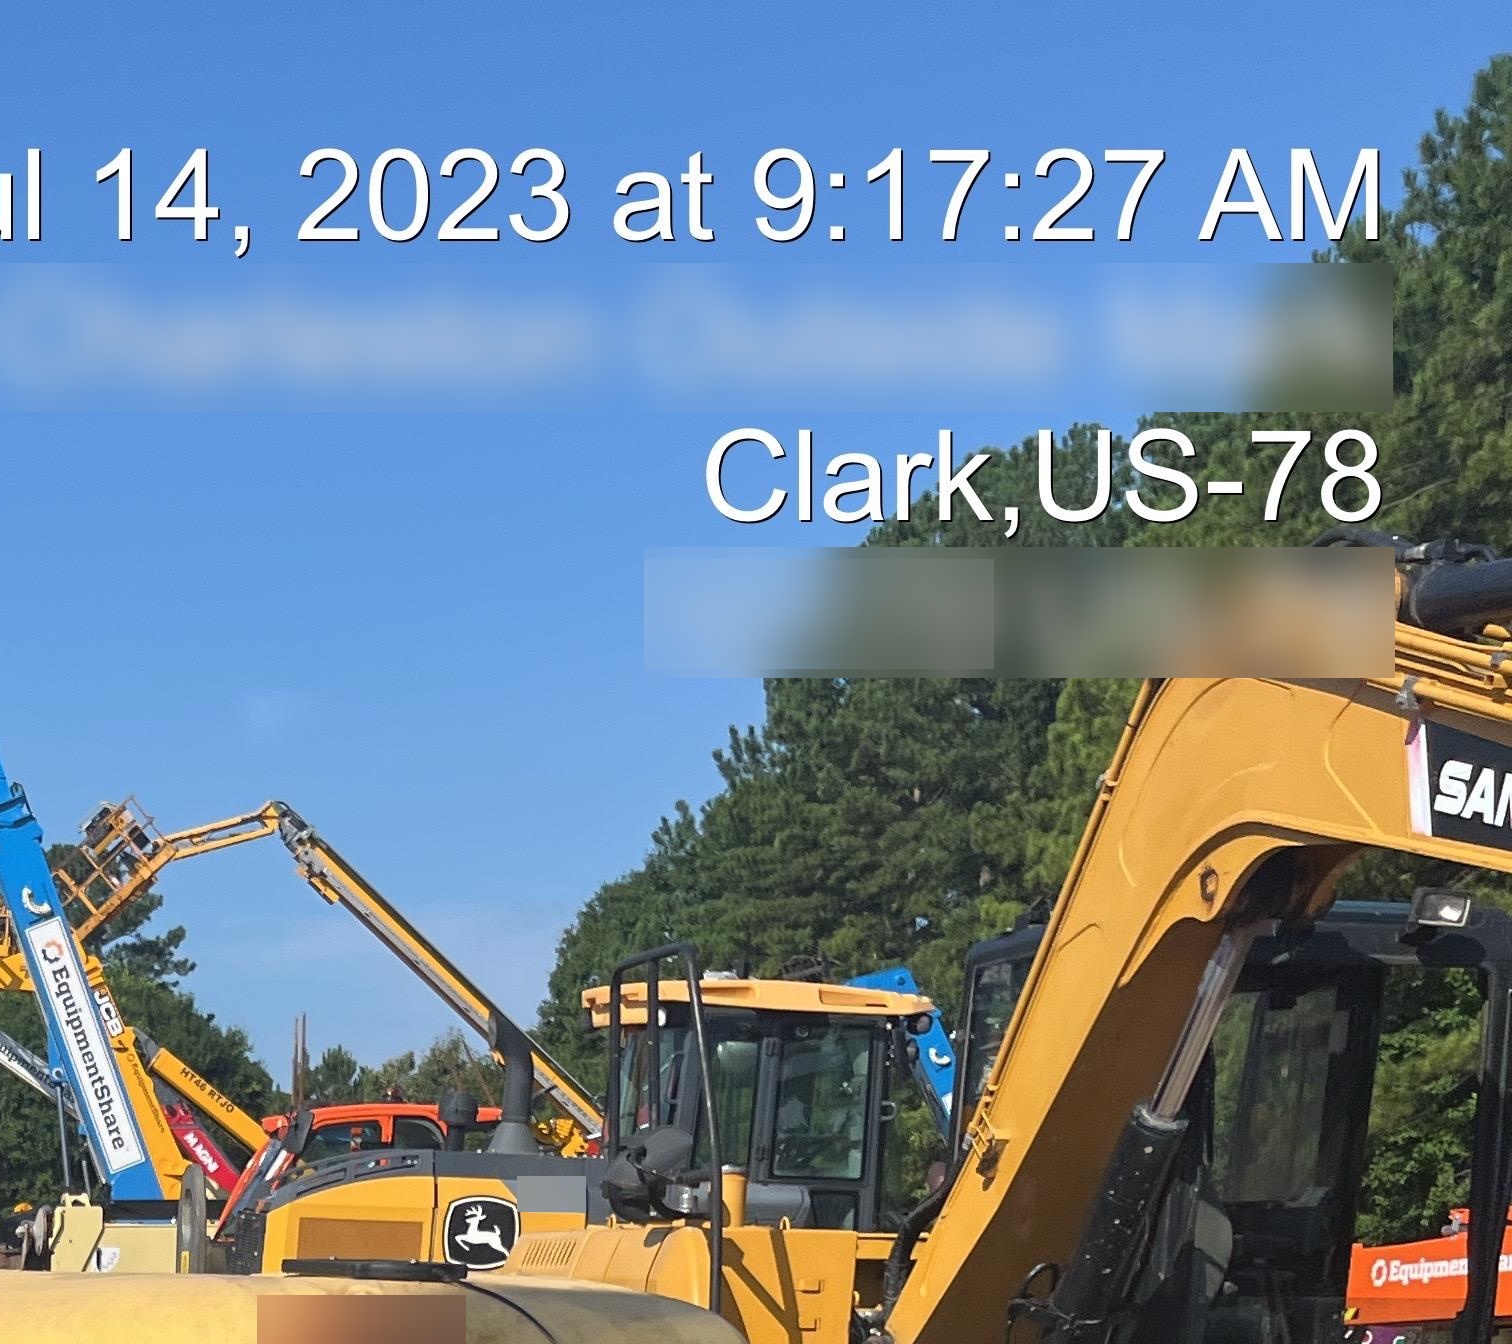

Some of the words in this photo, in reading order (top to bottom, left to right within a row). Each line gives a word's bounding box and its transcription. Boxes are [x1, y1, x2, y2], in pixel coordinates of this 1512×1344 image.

[94, 990, 123, 1038] JCB
[51, 965, 126, 1150] EquipmentShare
[180, 1066, 207, 1092] HT46
